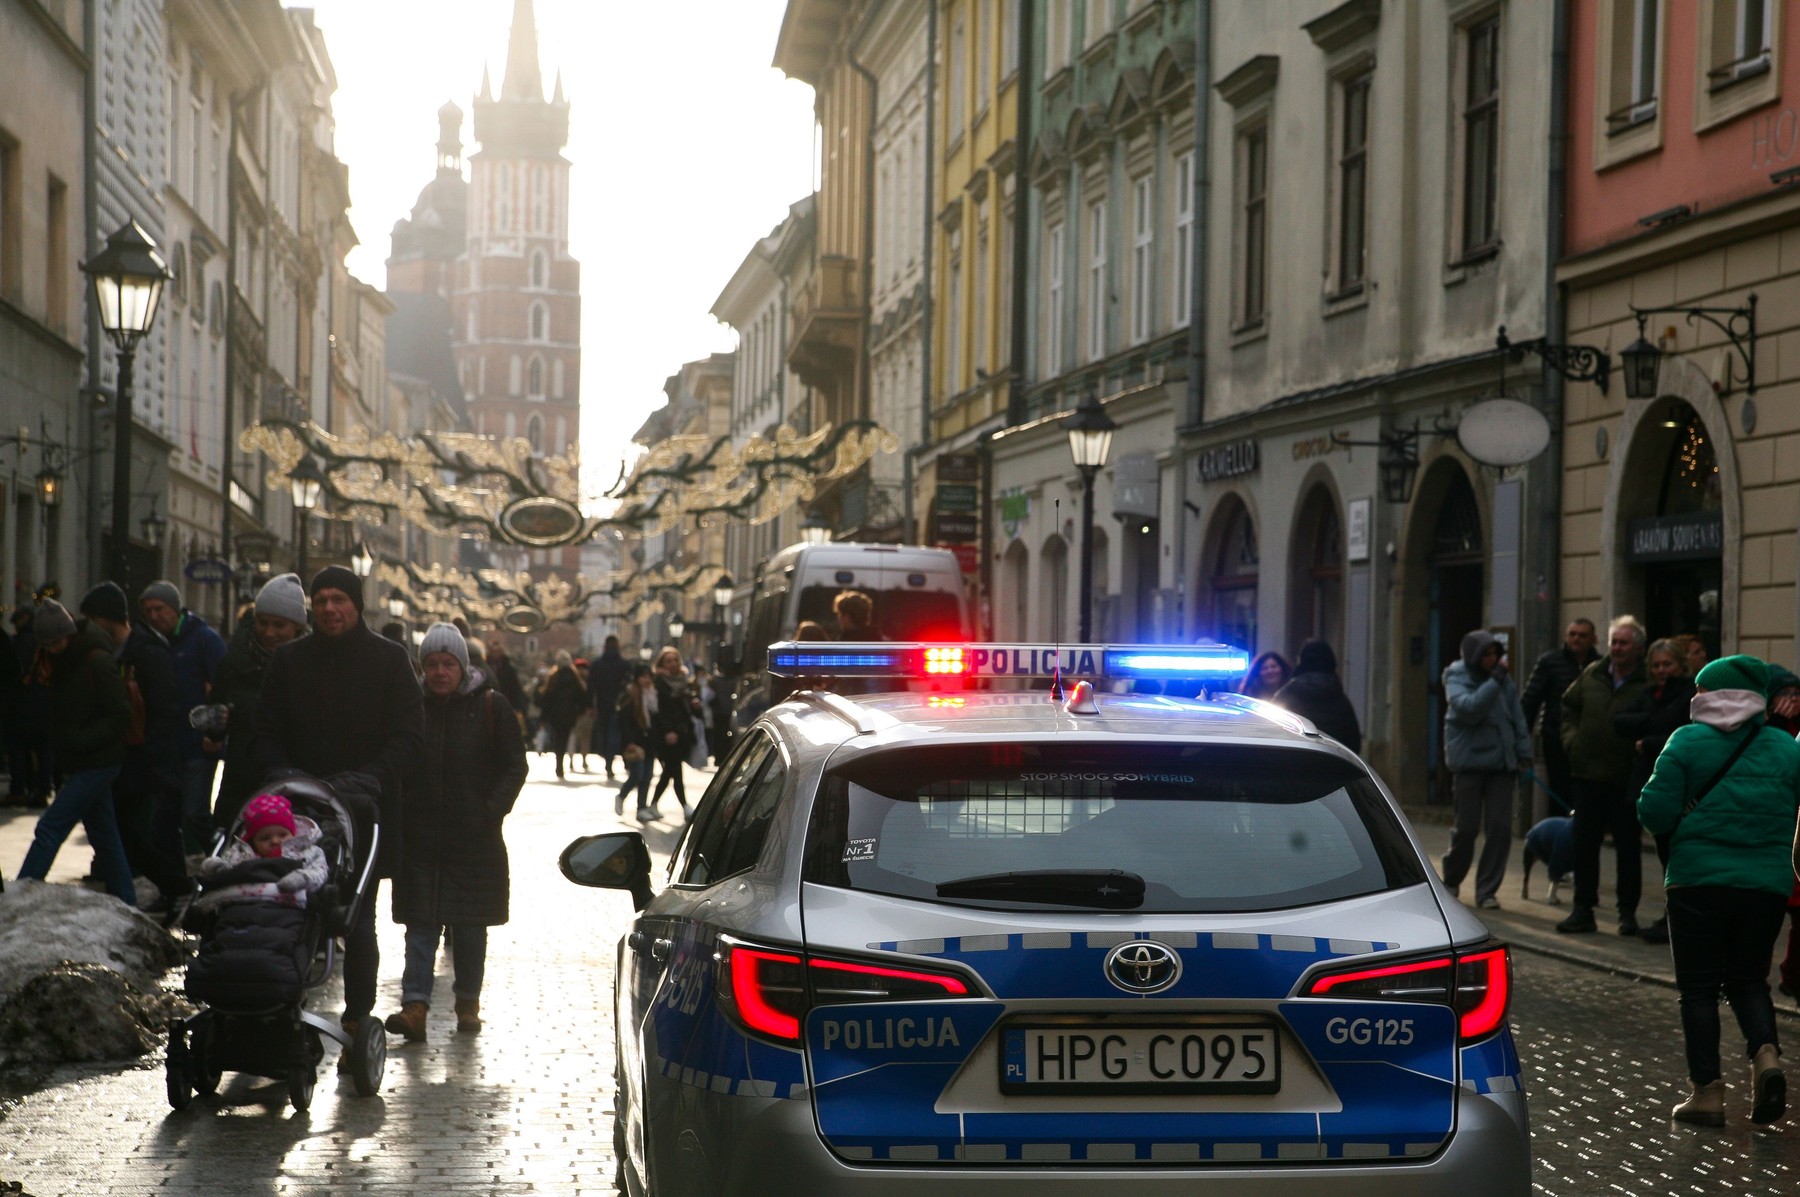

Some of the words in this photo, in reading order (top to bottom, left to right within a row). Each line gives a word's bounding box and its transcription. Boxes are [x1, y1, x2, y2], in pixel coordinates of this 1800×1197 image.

[972, 649, 1096, 675] POLICJA
[1020, 773, 1057, 781] STOP
[1060, 773, 1109, 781] SMOG
[863, 843, 874, 855] 1
[823, 1017, 960, 1050] POLICJA
[1037, 1034, 1128, 1080] HPG
[1149, 1034, 1266, 1080] C095
[1007, 1064, 1023, 1076] PL
